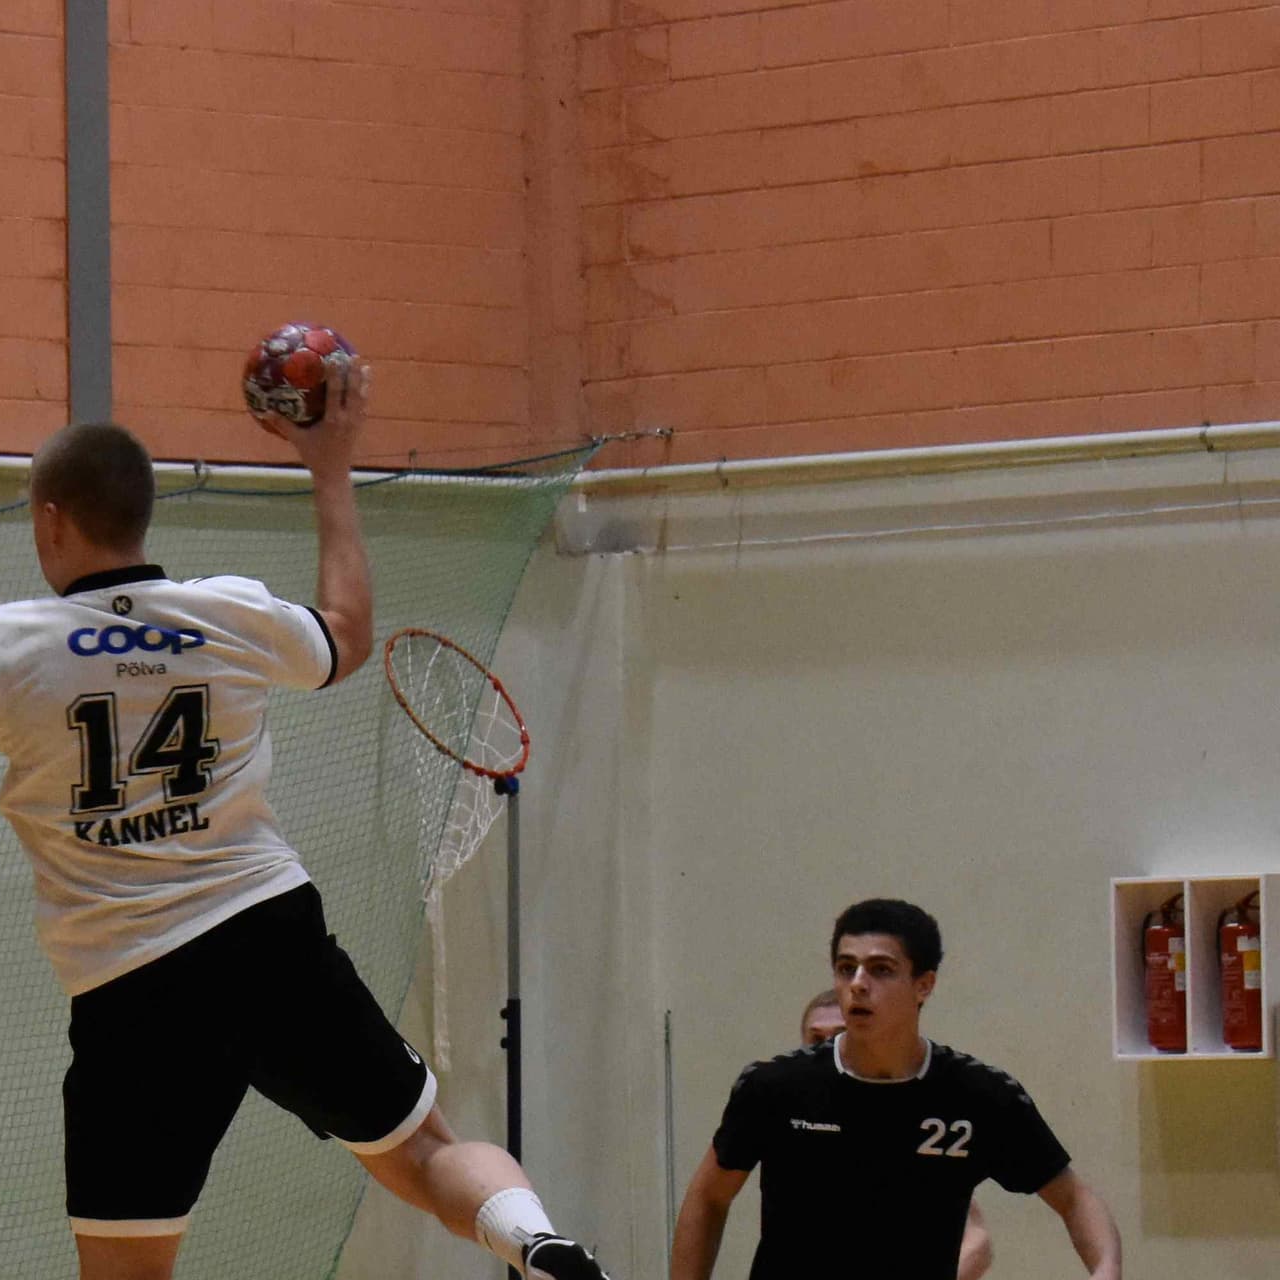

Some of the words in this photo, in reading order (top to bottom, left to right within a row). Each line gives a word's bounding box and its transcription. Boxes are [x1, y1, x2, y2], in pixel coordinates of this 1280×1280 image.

[116, 660, 167, 677] Põlva
[66, 684, 220, 815] 14
[74, 802, 209, 847] KANNEL
[916, 1117, 973, 1157] 22
